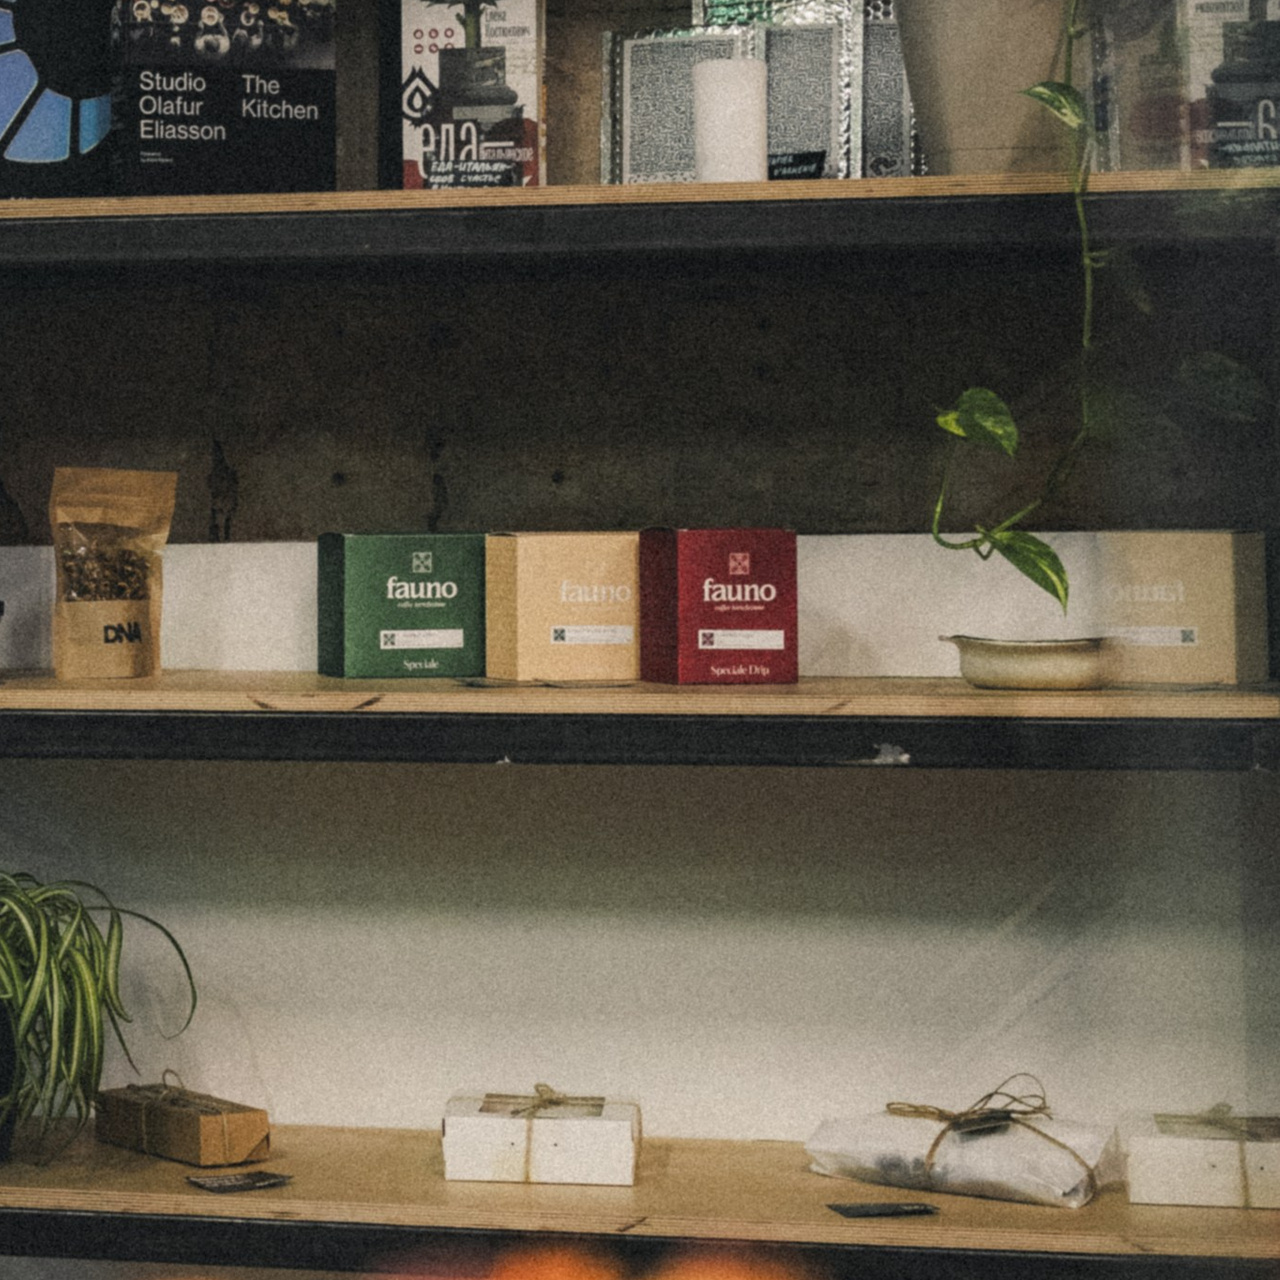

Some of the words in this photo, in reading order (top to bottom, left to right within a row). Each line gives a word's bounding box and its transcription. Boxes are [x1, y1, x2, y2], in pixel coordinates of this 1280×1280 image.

[139, 70, 207, 92] Studio
[241, 74, 281, 95] The
[139, 95, 204, 117] Olafur
[241, 98, 319, 120] Kitchen
[139, 119, 227, 141] Eliasson
[386, 576, 458, 599] fauno
[559, 580, 631, 604] fauno
[703, 578, 777, 602] fauno
[103, 621, 142, 644] DNA
[710, 665, 747, 677] Speciale
[748, 665, 770, 677] Drip
